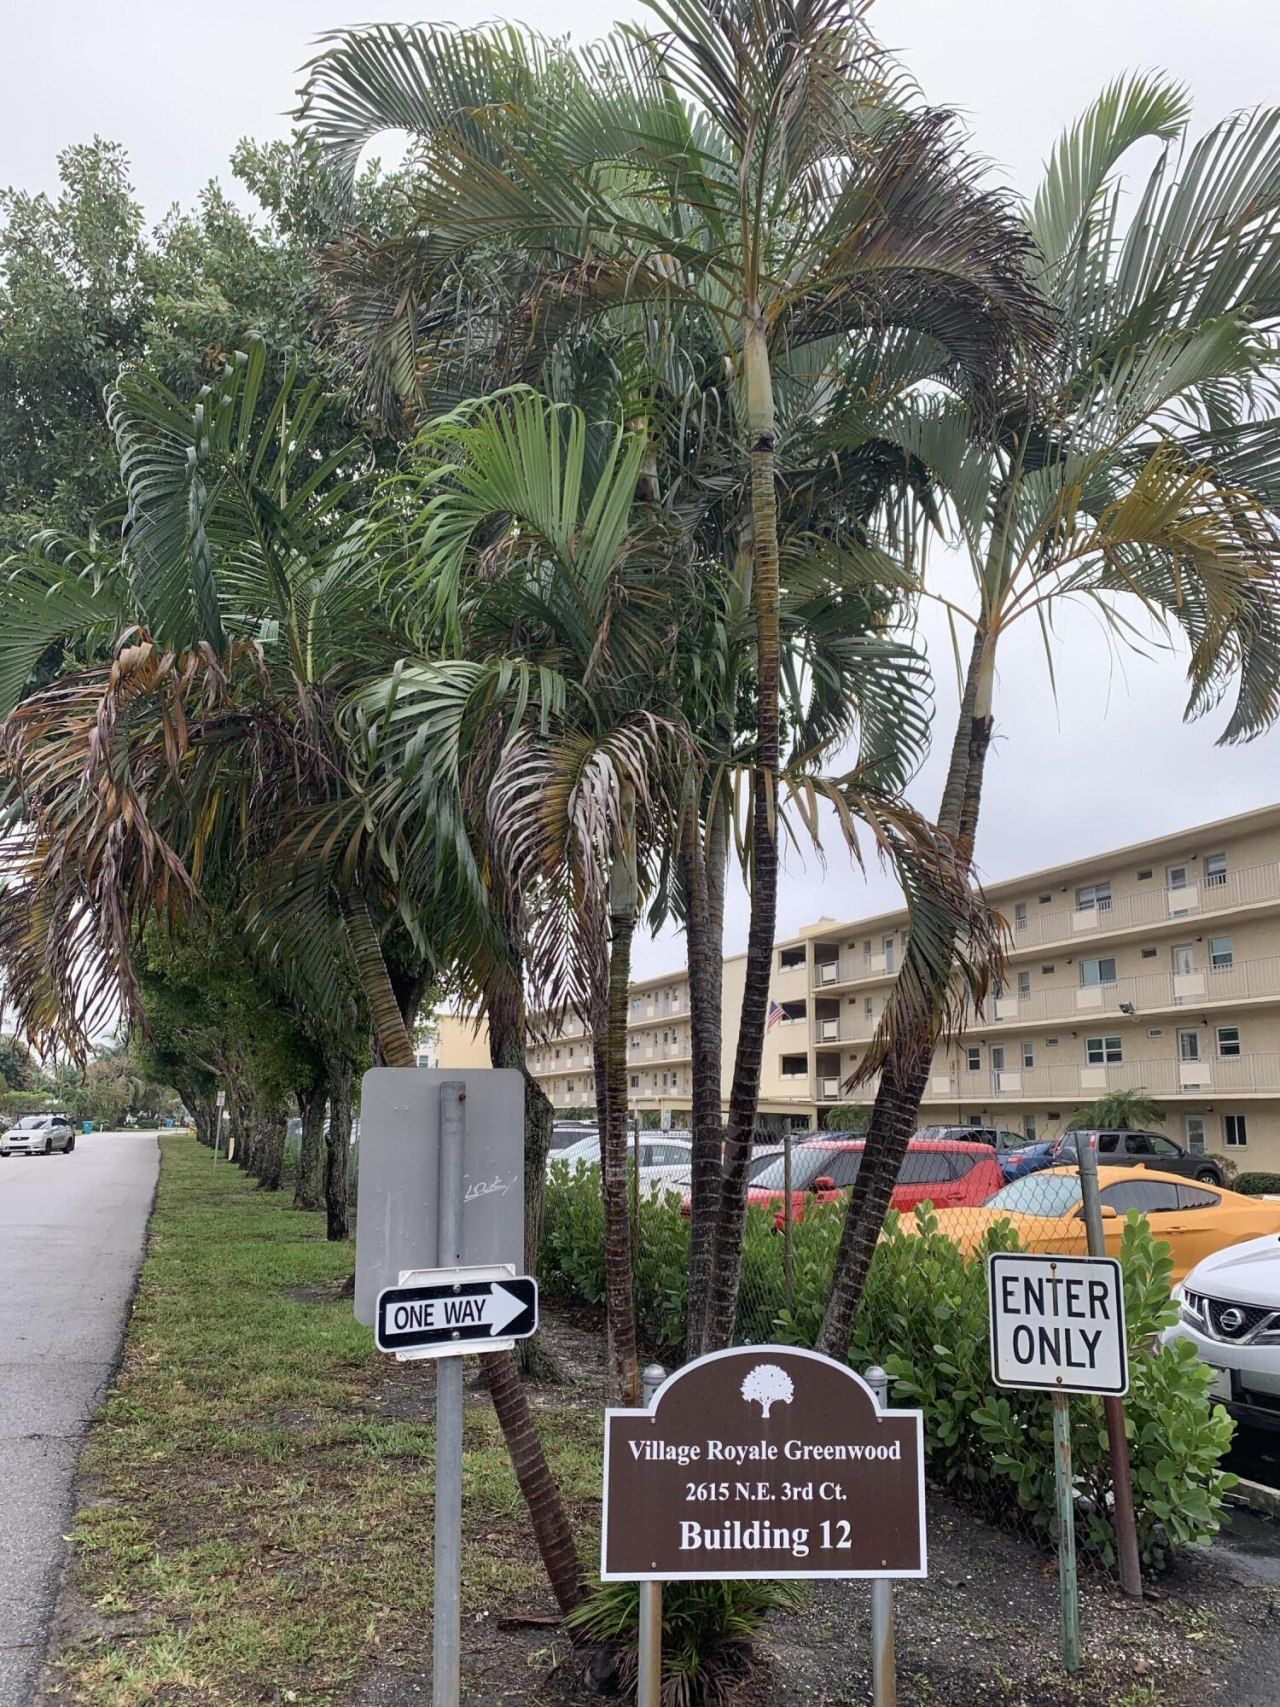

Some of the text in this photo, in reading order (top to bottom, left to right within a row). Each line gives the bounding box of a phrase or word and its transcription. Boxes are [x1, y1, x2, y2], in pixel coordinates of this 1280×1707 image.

[1002, 1276, 1110, 1319] ENTER
[394, 1299, 486, 1330] ONE WAY
[1013, 1325, 1102, 1368] ONLY
[628, 1440, 901, 1465] Village Royale Greenwood
[686, 1482, 847, 1501] 2615 N.E. 3rd Ct.
[679, 1520, 852, 1556] Building 12
